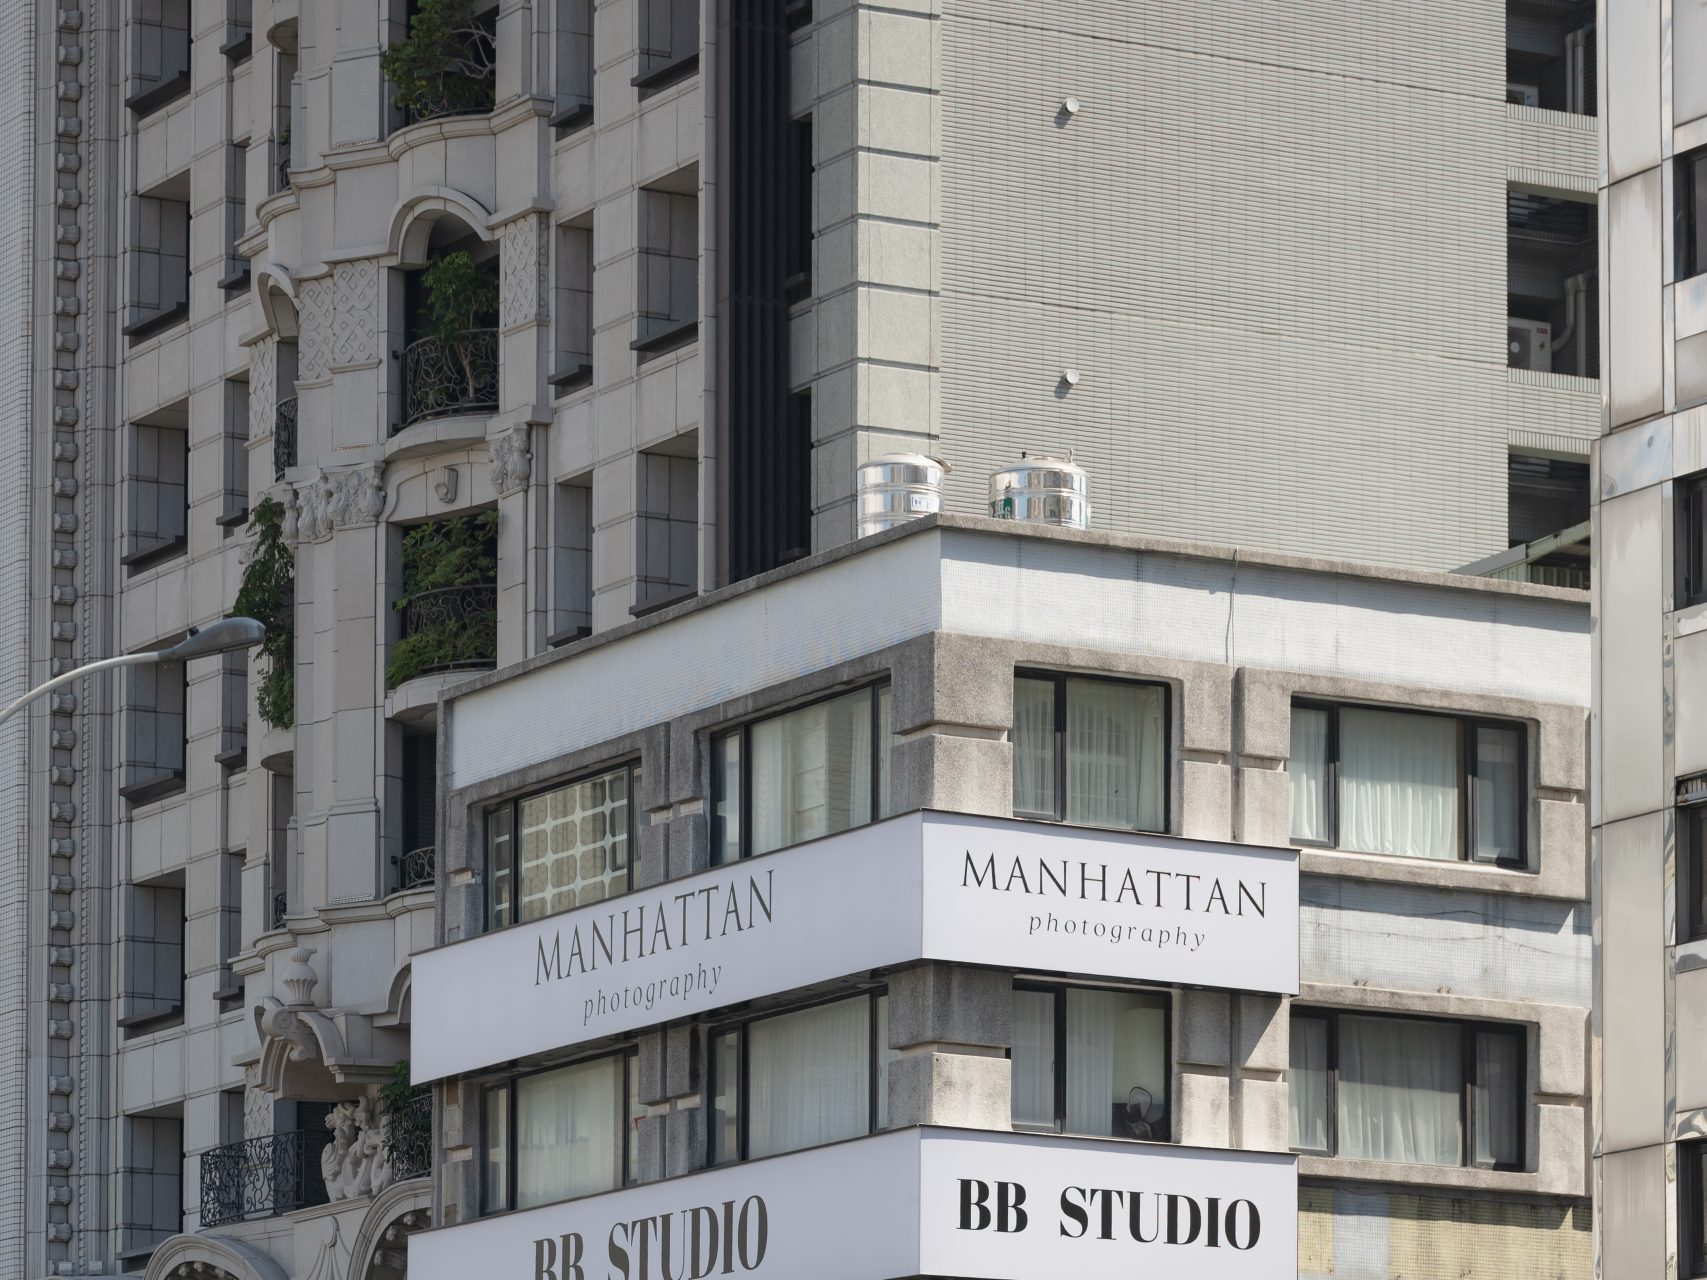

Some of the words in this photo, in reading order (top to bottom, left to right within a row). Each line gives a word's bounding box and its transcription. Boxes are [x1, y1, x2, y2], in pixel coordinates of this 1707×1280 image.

[960, 849, 1266, 918] MANHATTAN
[534, 870, 774, 986] MANHATTAN
[1029, 912, 1206, 951] photography
[584, 963, 721, 1025] photography
[956, 1178, 1027, 1233] BB
[1060, 1186, 1260, 1250] STUDIO
